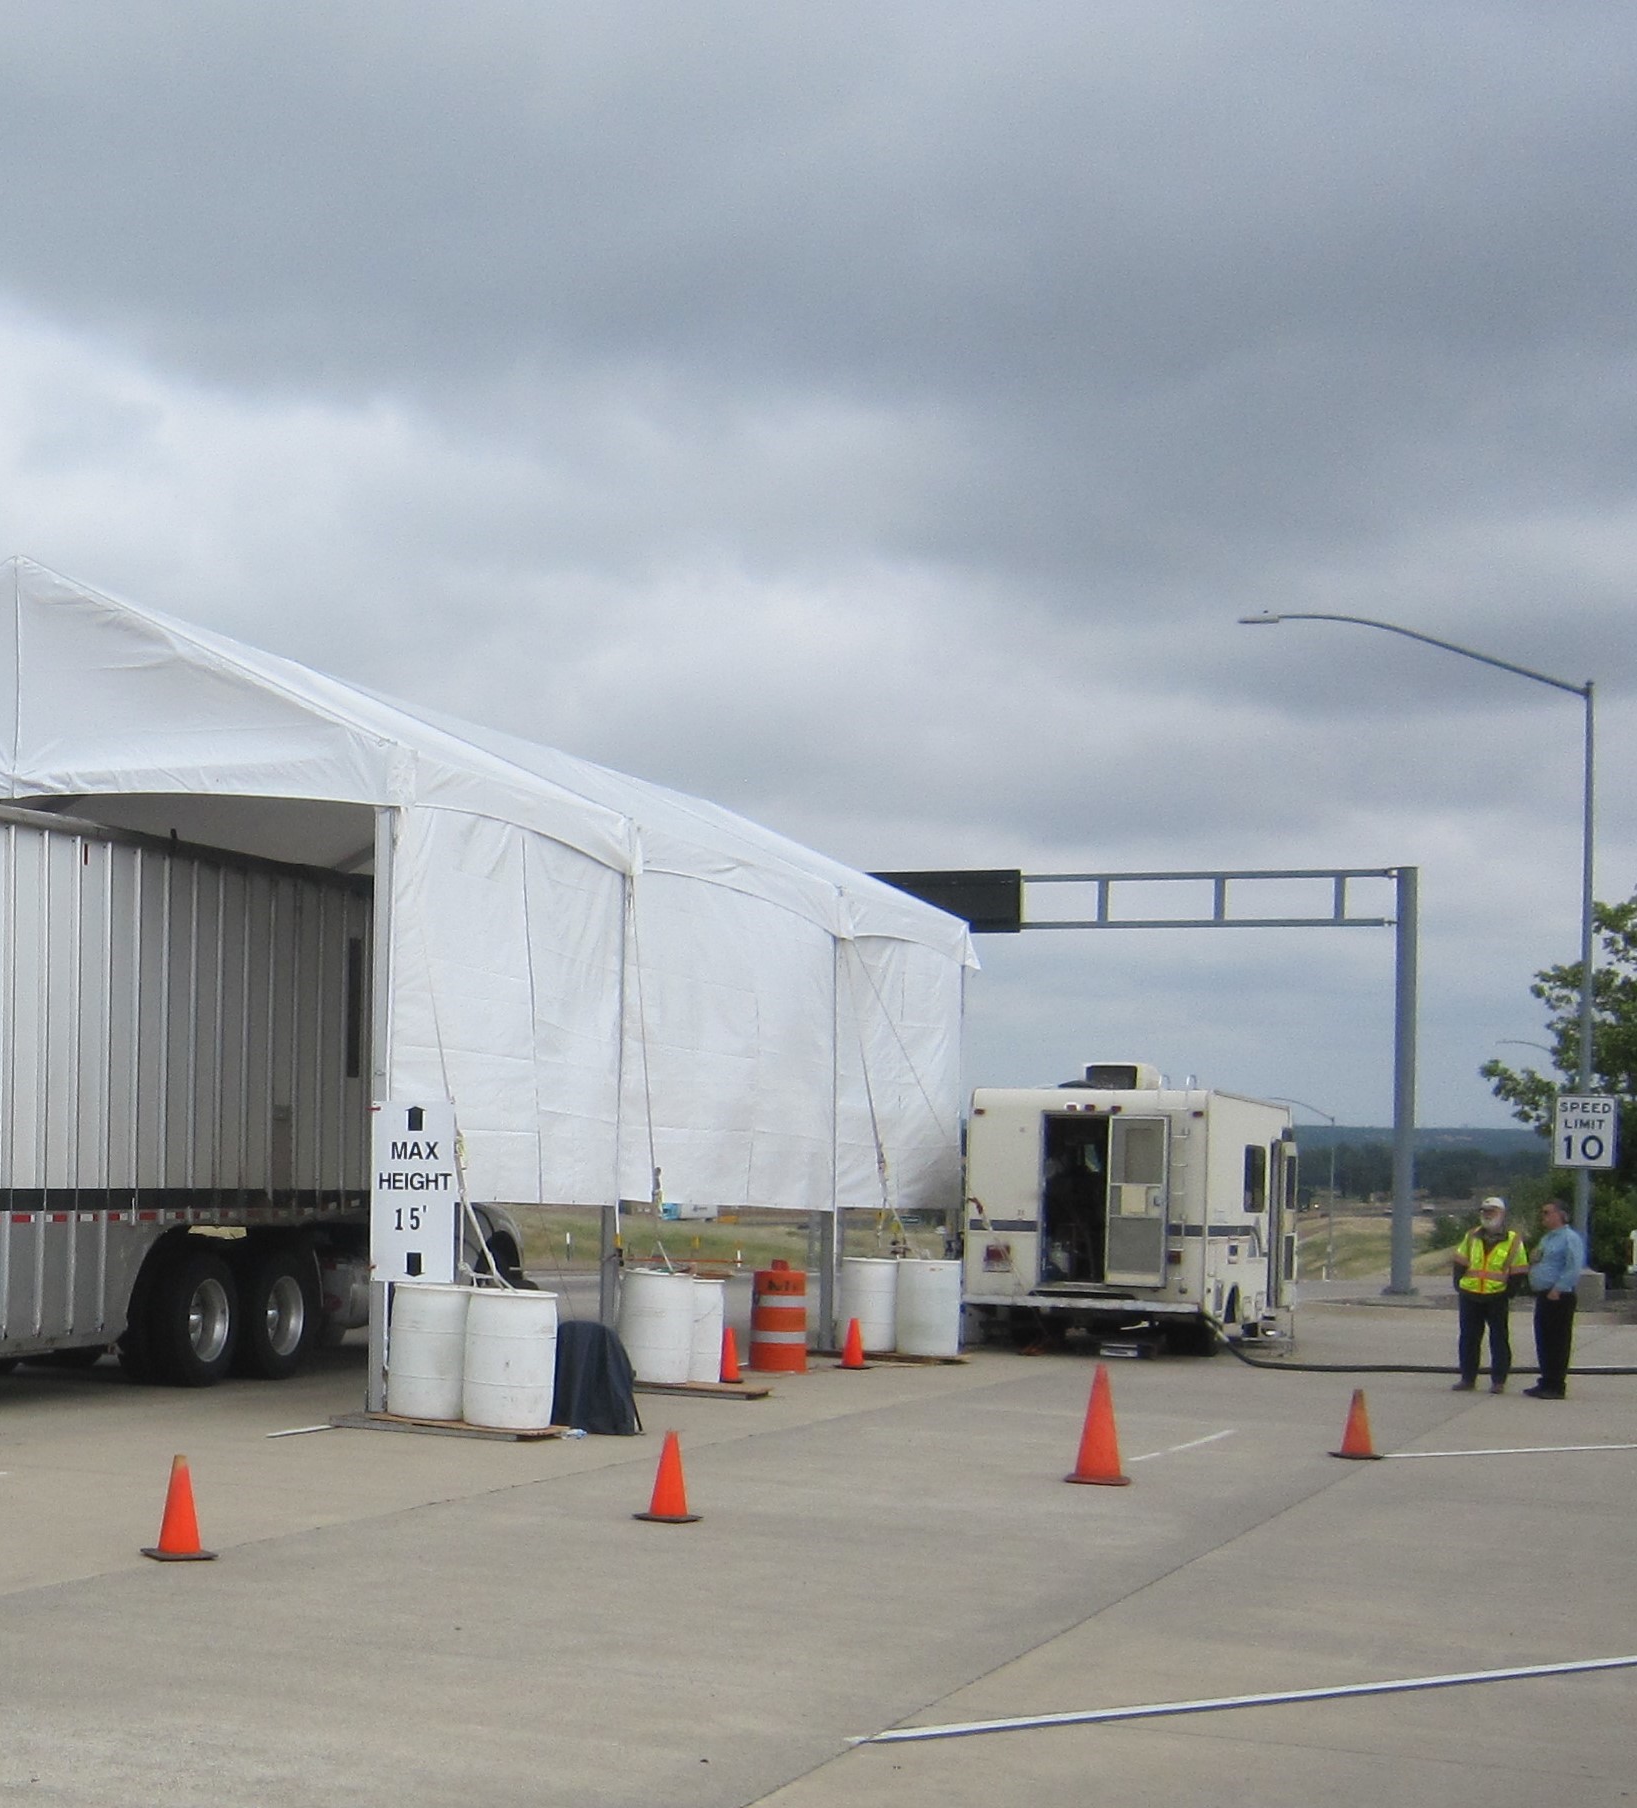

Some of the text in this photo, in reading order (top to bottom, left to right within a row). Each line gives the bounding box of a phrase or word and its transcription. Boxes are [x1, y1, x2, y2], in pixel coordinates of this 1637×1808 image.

[1559, 1102, 1612, 1114] SPEED
[1564, 1119, 1605, 1130] LIMIT
[391, 1141, 439, 1160] MAX
[1563, 1134, 1604, 1161] 10
[379, 1172, 452, 1191] HEIGHT
[395, 1205, 427, 1231] 15'
